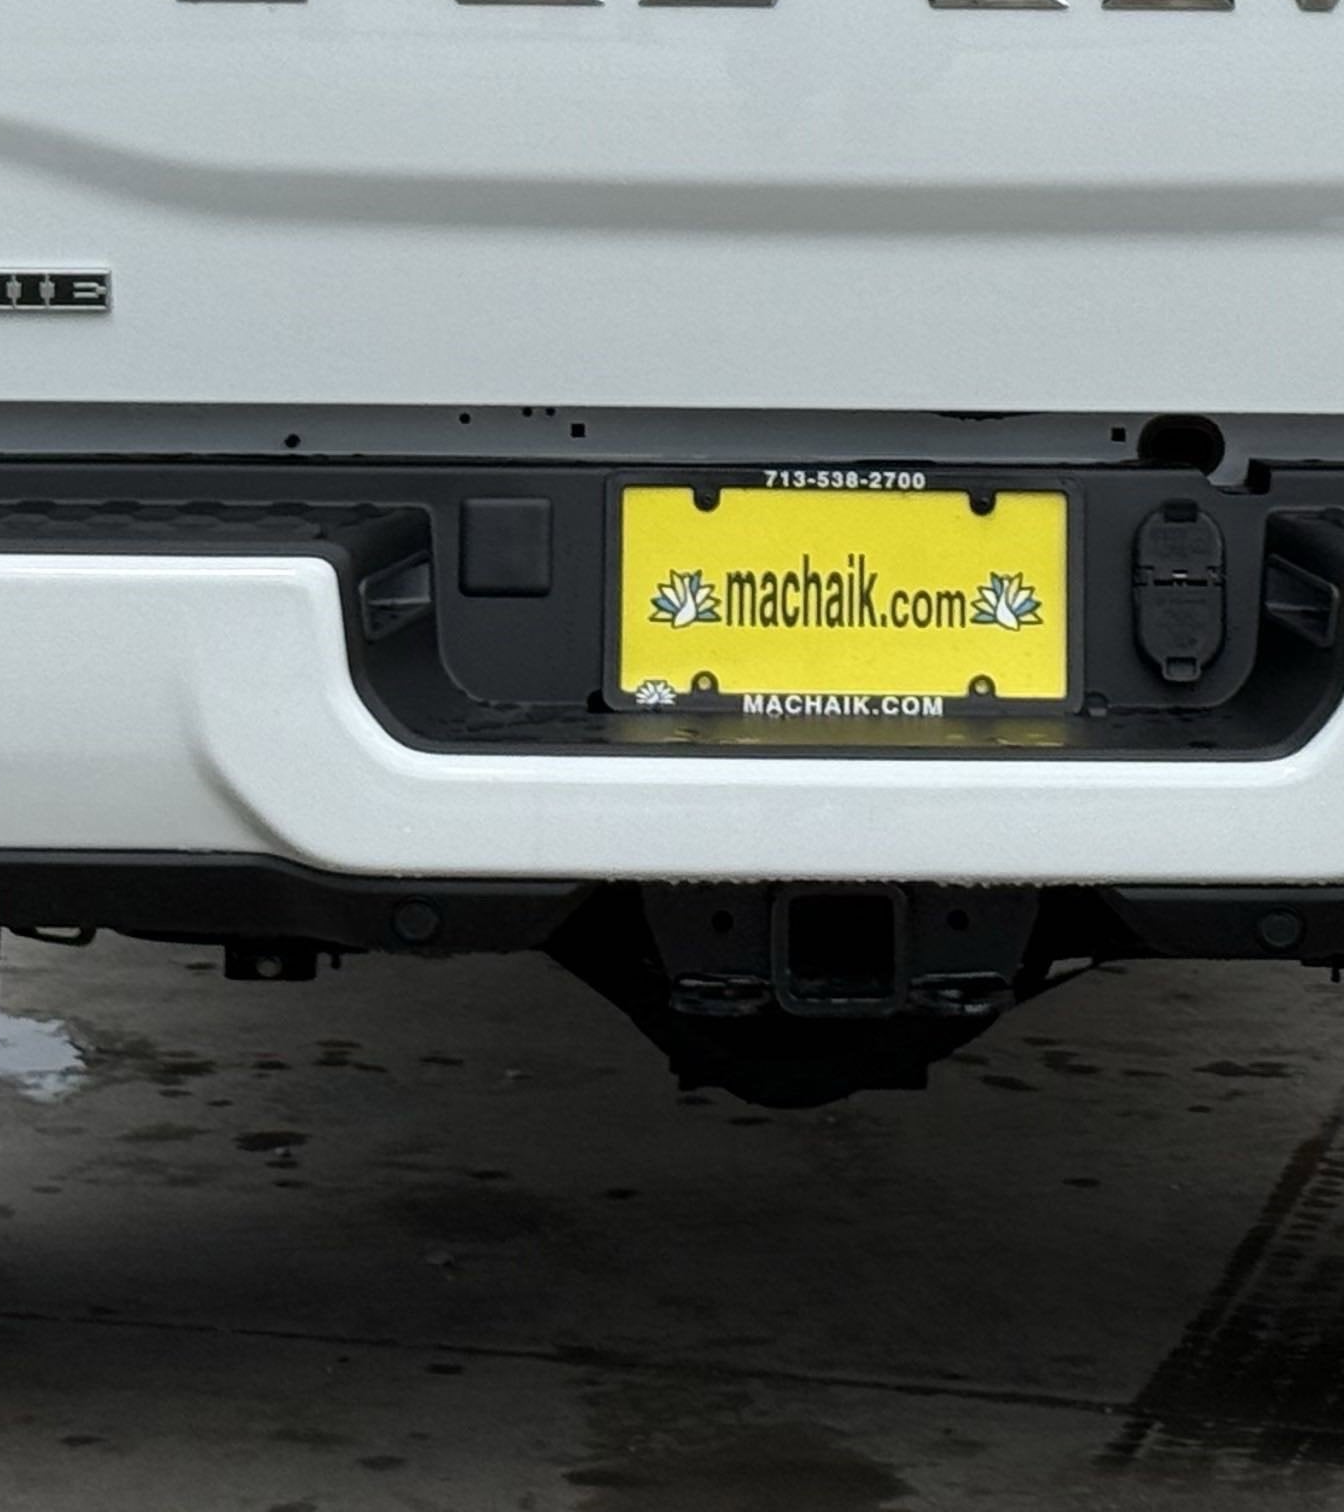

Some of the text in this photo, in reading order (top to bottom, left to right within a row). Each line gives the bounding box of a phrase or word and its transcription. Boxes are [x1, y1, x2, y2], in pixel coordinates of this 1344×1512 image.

[763, 470, 926, 490] 713-538-2700
[725, 553, 966, 629] machaik.com
[742, 694, 944, 717] MACHAIK.COM
